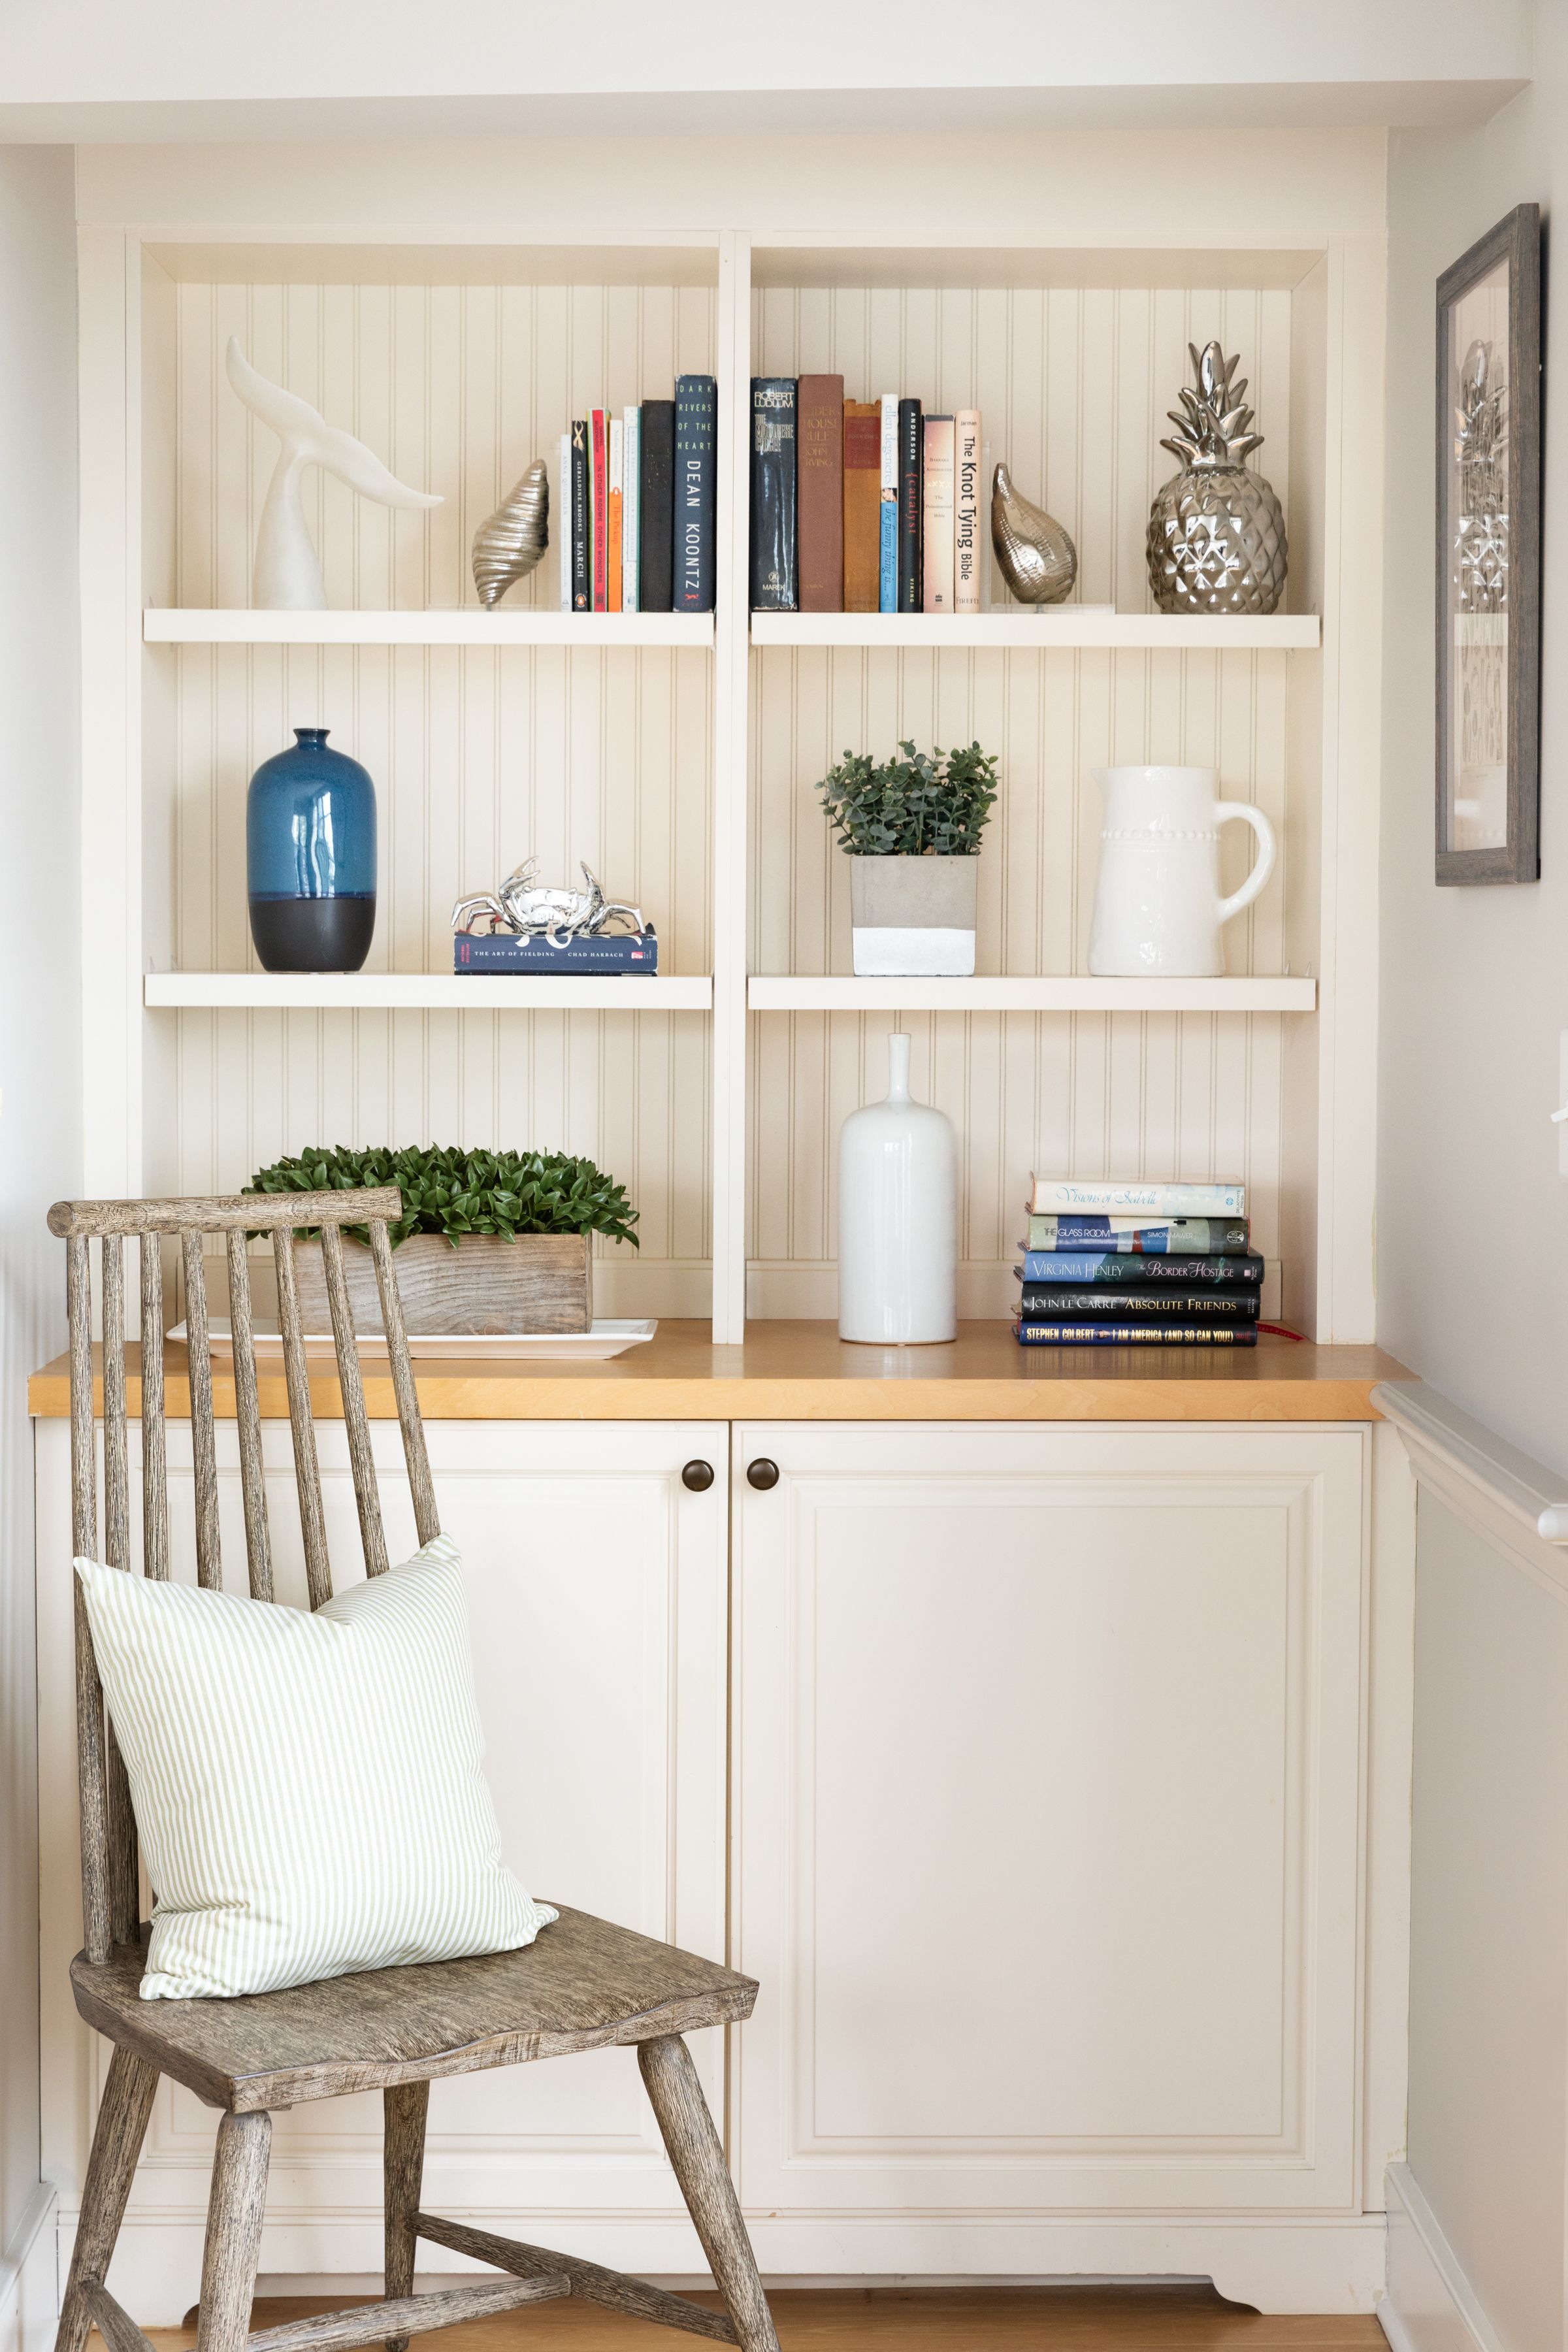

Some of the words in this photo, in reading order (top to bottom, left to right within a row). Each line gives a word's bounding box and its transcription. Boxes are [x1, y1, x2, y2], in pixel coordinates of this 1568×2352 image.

[754, 391, 795, 400] ROBERT
[754, 400, 793, 408] LUDLUM
[679, 404, 711, 412] RIVERS
[885, 405, 896, 429] ellen
[696, 423, 711, 431] THE
[755, 414, 766, 425] THE
[678, 442, 711, 450] HEART
[964, 436, 975, 457] The
[882, 433, 896, 485] degeneres
[687, 461, 701, 506] DEAN
[961, 462, 977, 501] Knot
[612, 521, 621, 545] Pickup
[882, 520, 896, 549] funny
[957, 505, 977, 549] Tying
[685, 523, 700, 589] KOONTZ
[882, 550, 895, 574] thing
[961, 553, 973, 581] Bible
[1056, 1186, 1100, 1203] Visions
[1101, 1191, 1113, 1208] of
[1043, 1228, 1057, 1236] THE
[1057, 1228, 1083, 1237] GLASS
[1084, 1229, 1111, 1237] ROOM
[1032, 1260, 1082, 1277] VIRGINIA
[1085, 1263, 1124, 1278] HENLEY
[1146, 1260, 1188, 1277] BORDER
[1188, 1262, 1234, 1278] HOSTAGE
[1030, 1296, 1059, 1311] JOHN
[1062, 1299, 1074, 1309] LE
[1126, 1298, 1184, 1311] ABSOLUTE
[1188, 1298, 1237, 1311] FRIENDS
[1026, 1328, 1060, 1340] STEPHEN
[1062, 1328, 1096, 1341] COLBERT
[1112, 1329, 1116, 1341] I
[1117, 1329, 1129, 1341] AM
[1131, 1329, 1162, 1342] AMERICA
[1164, 1330, 1183, 1343] (AND
[1184, 1330, 1195, 1342] SO
[1196, 1330, 1211, 1342] CAN
[1213, 1330, 1234, 1343] YOU!)
